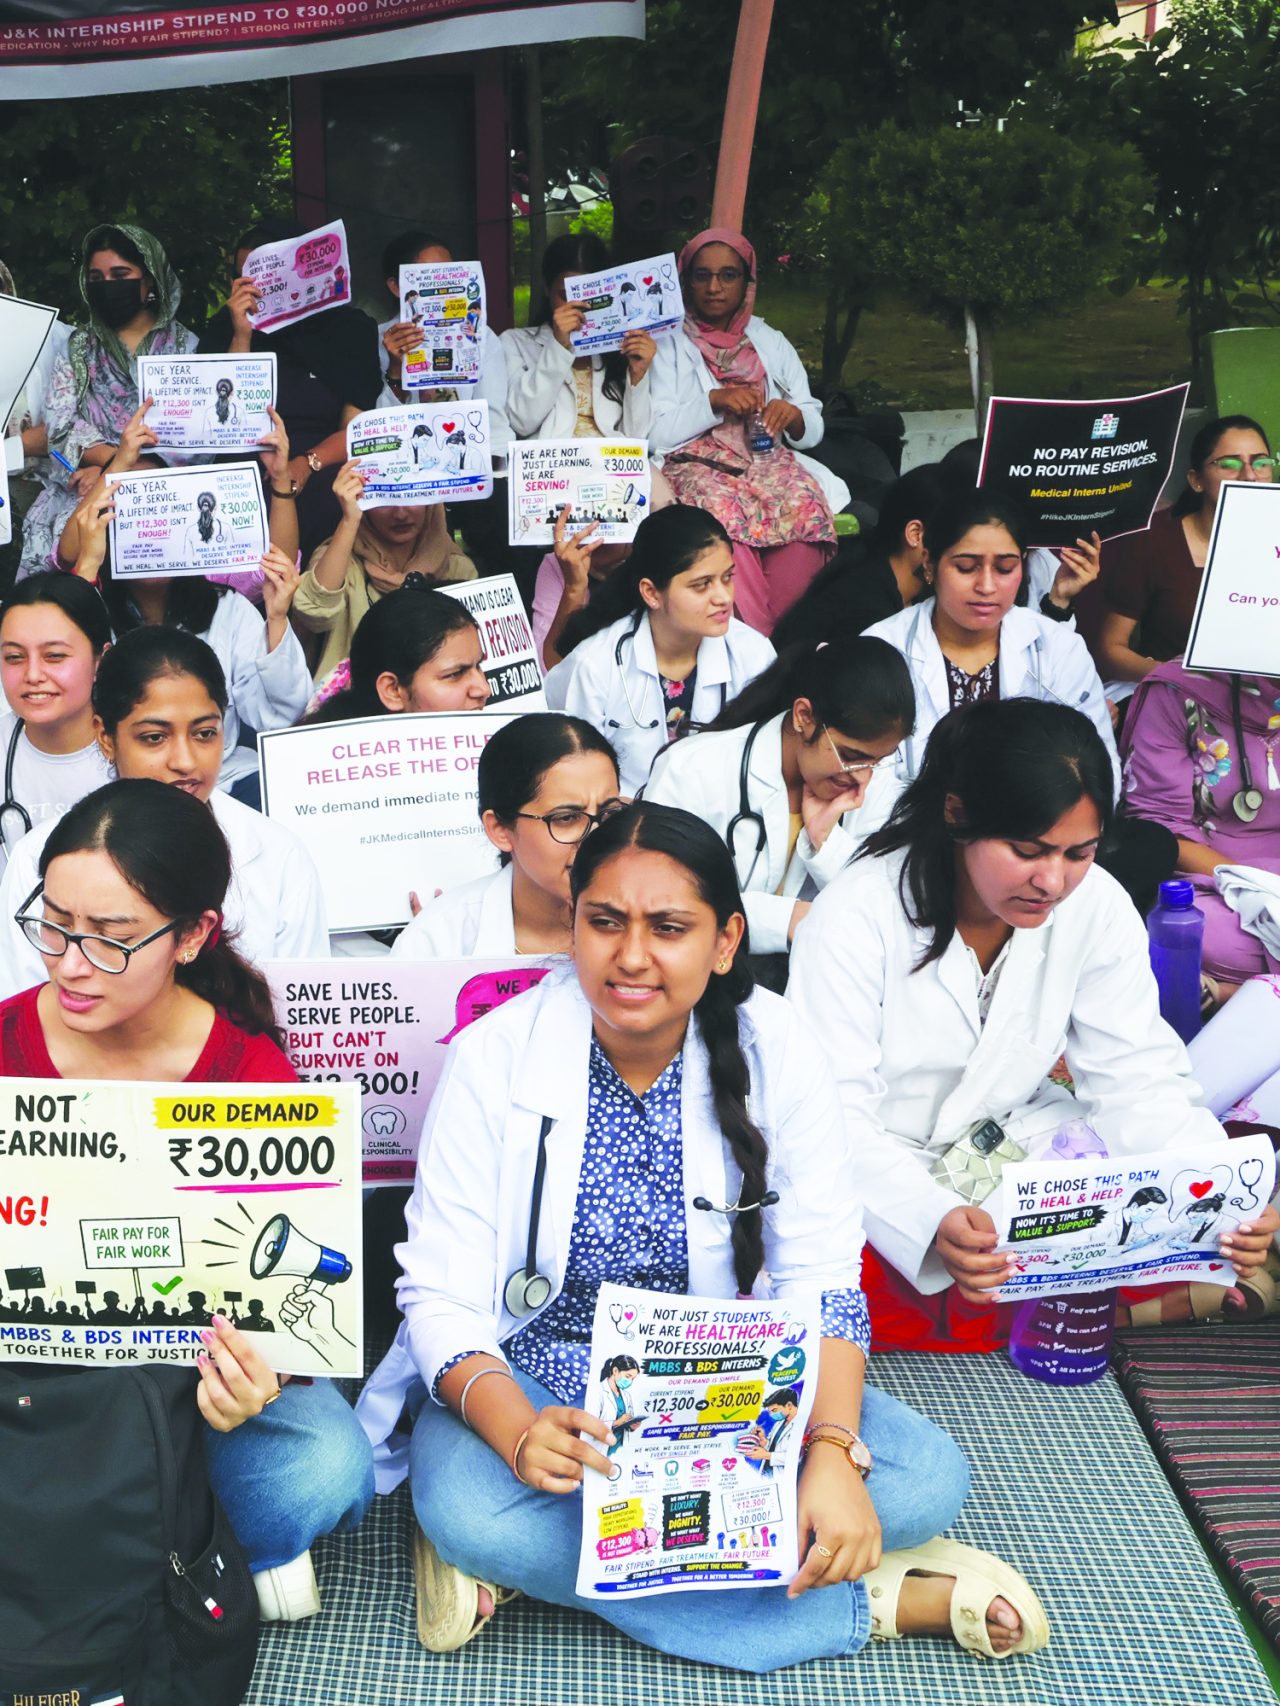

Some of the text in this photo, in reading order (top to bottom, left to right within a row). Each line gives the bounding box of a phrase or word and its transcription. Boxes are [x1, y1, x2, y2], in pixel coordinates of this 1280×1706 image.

[4, 28, 40, 39] J&K
[48, 19, 166, 38] INTERNSHIP
[172, 10, 257, 29] STIPEND
[264, 8, 289, 20] TO
[296, 2, 368, 17] ₹30,000
[72, 40, 99, 48] WHY
[103, 38, 126, 47] NOT
[131, 36, 138, 44] A
[142, 34, 169, 43] FAIR
[173, 26, 229, 40] STIPEND?
[241, 22, 290, 34] STRONG
[294, 18, 345, 30] INTERNS
[521, 448, 579, 459] WE ARE NOT
[1034, 440, 1149, 460] NO PAY REVISION.
[604, 459, 644, 472] ₹30,000
[1009, 452, 1158, 476] NO ROUTINE SERVICES.
[118, 481, 167, 495] ONE YEAR
[525, 480, 570, 492] SERVING!
[1030, 488, 1071, 498] Medical
[1073, 486, 1106, 496] Interns
[133, 496, 143, 504] OF
[232, 517, 254, 527] NOW!
[486, 591, 494, 609] IS
[1229, 592, 1280, 608] Can yo
[485, 613, 533, 658] REVISION
[488, 662, 540, 696] TO ₹30,000
[332, 740, 401, 760] CLEAR
[407, 736, 446, 753] THE
[307, 762, 402, 785] RELEASE
[407, 758, 448, 775] THE
[294, 803, 318, 817] We
[321, 797, 380, 814] demand
[384, 792, 460, 807] immediate
[286, 982, 398, 1001] SAVE LIVES.
[287, 1006, 421, 1025] SERVE PEOPLE.
[289, 1030, 387, 1049] BUT CAN'T
[290, 1052, 399, 1069] SURVIVE ON
[15, 1094, 78, 1123] NOT
[172, 1102, 320, 1123] OUR DEMAND
[168, 1134, 336, 1183] ₹30,000
[1017, 1169, 1160, 1196] WE CHOSE THIS PATH
[1018, 1188, 1124, 1211] TO HEAL & HELP.
[91, 1224, 171, 1243] FAIR PAY FOR
[96, 1244, 172, 1261] FAIR WORK
[0, 1327, 204, 1346] MBBS & BDS INTERN
[3, 1343, 98, 1361] TOGETHER
[105, 1347, 139, 1361] FOR
